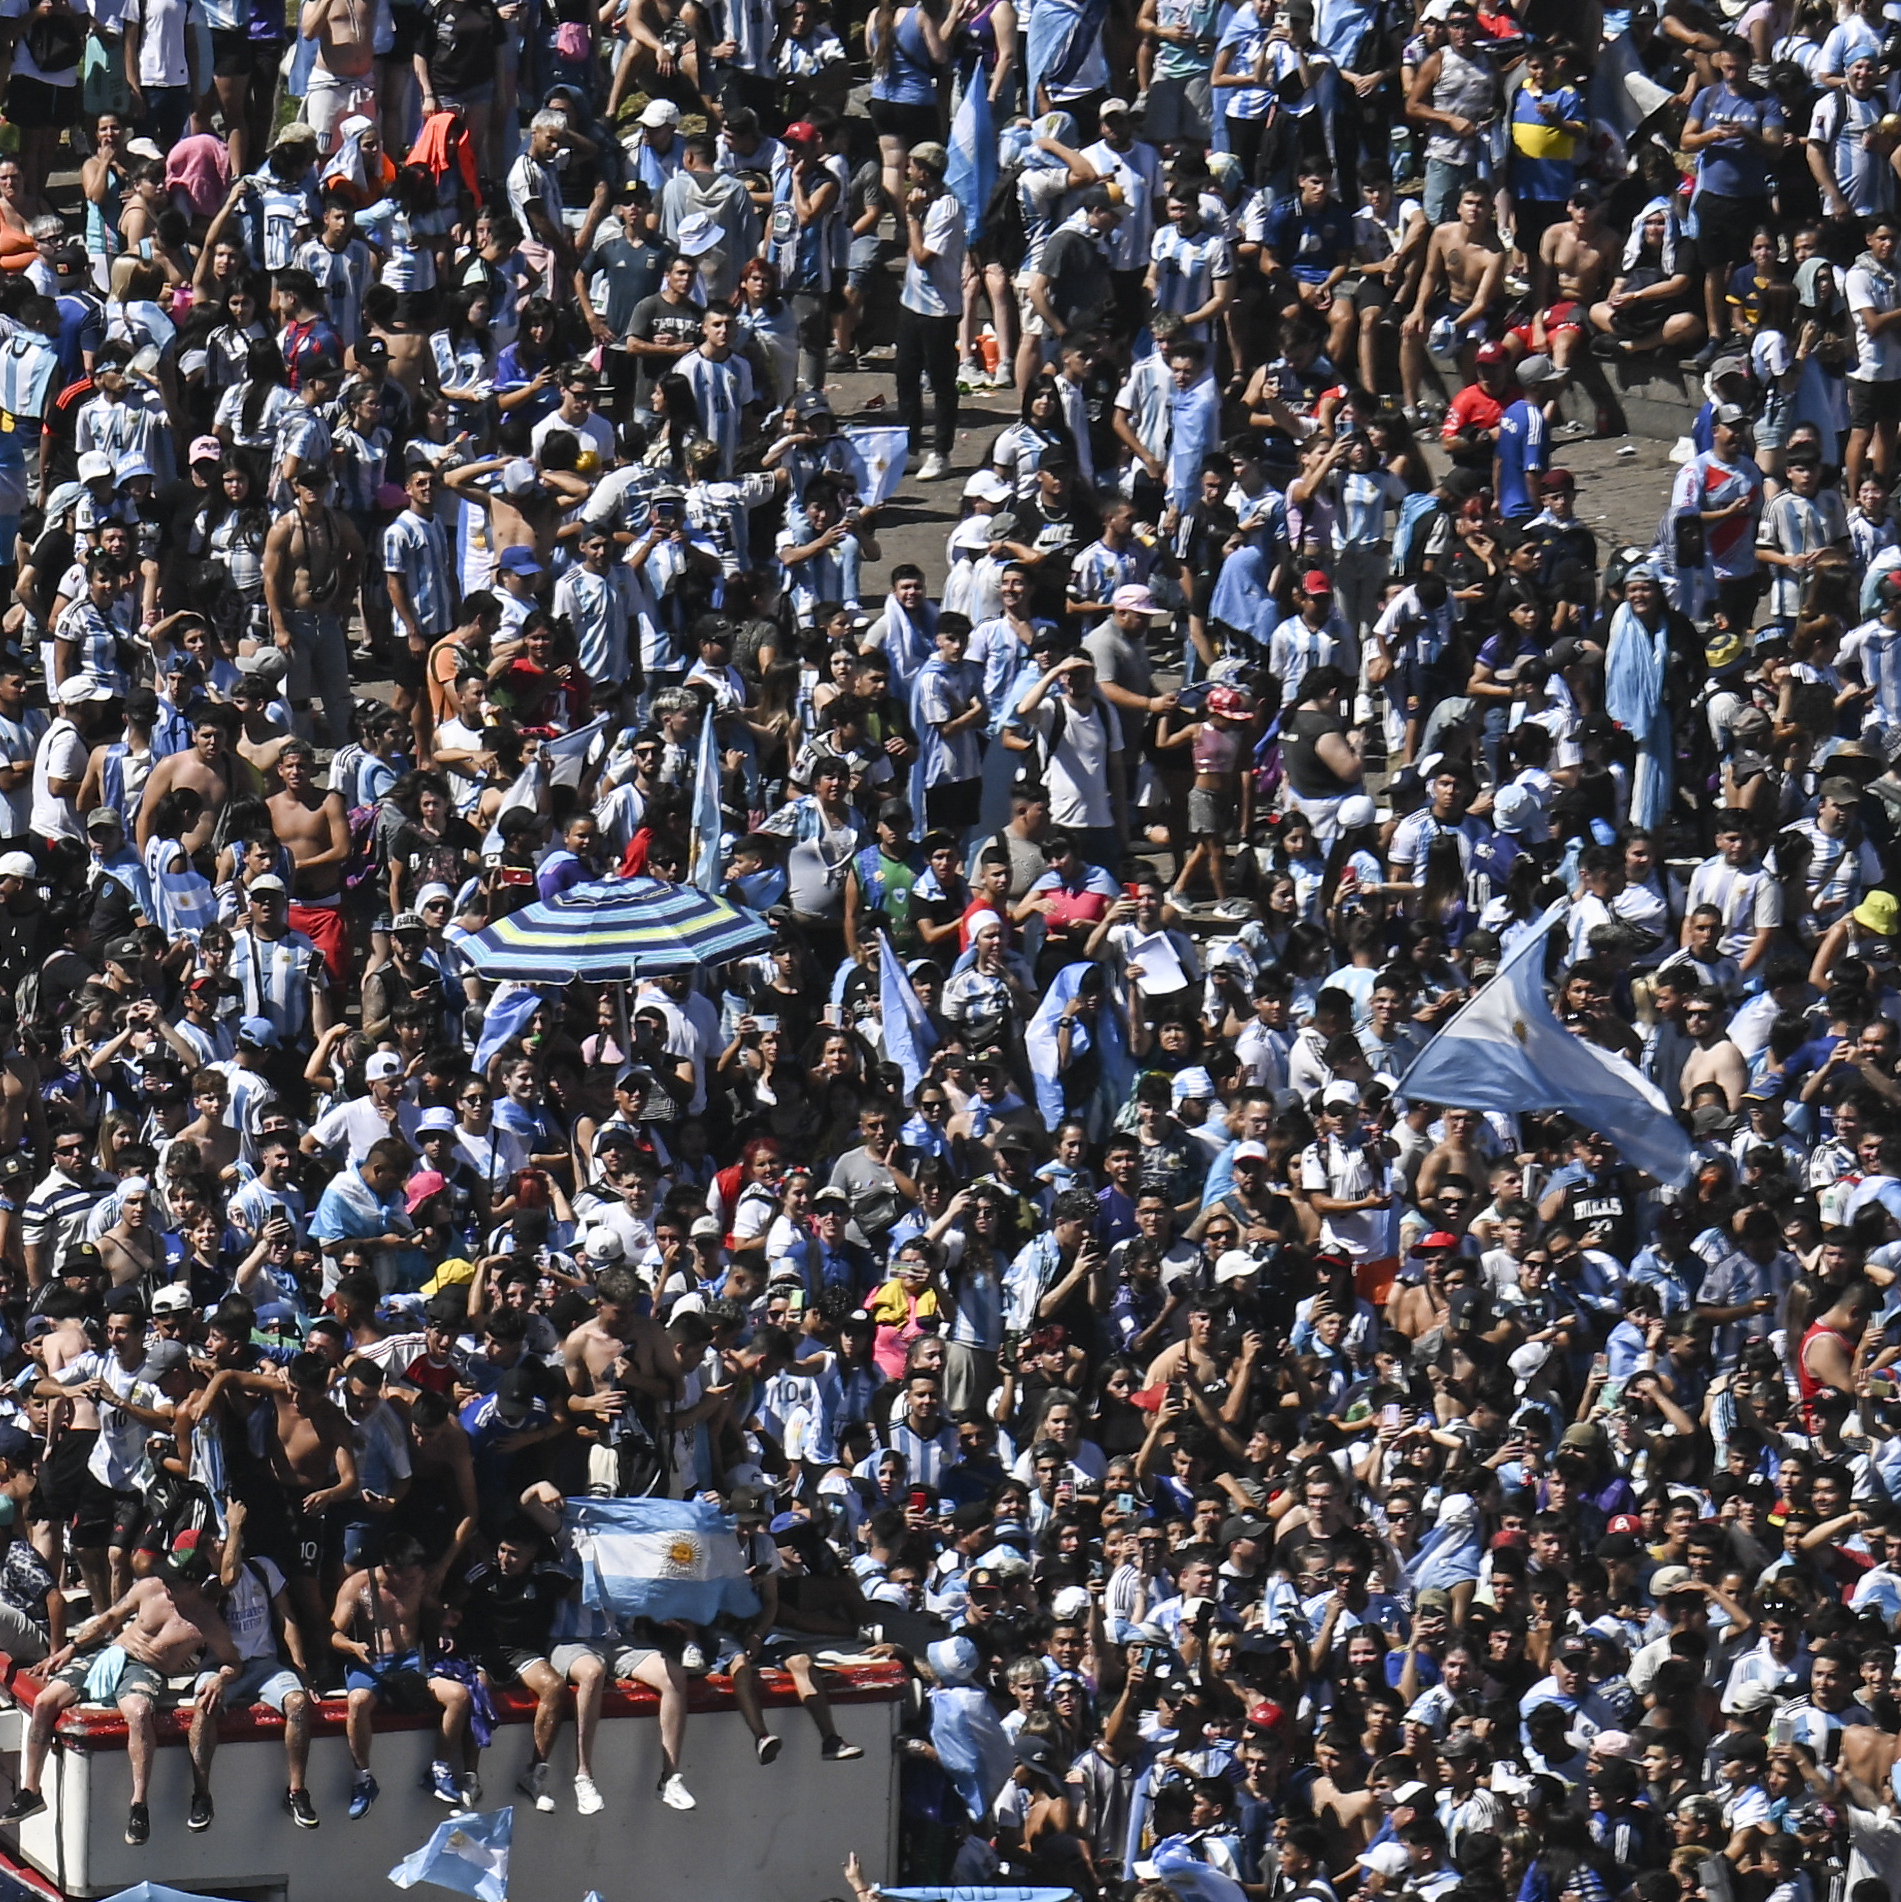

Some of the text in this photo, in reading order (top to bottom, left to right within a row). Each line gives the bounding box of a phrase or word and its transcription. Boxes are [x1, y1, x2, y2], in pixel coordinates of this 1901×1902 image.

[1573, 1198, 1623, 1219] BULLS
[776, 1380, 799, 1403] 10
[300, 1541, 317, 1559] 10
